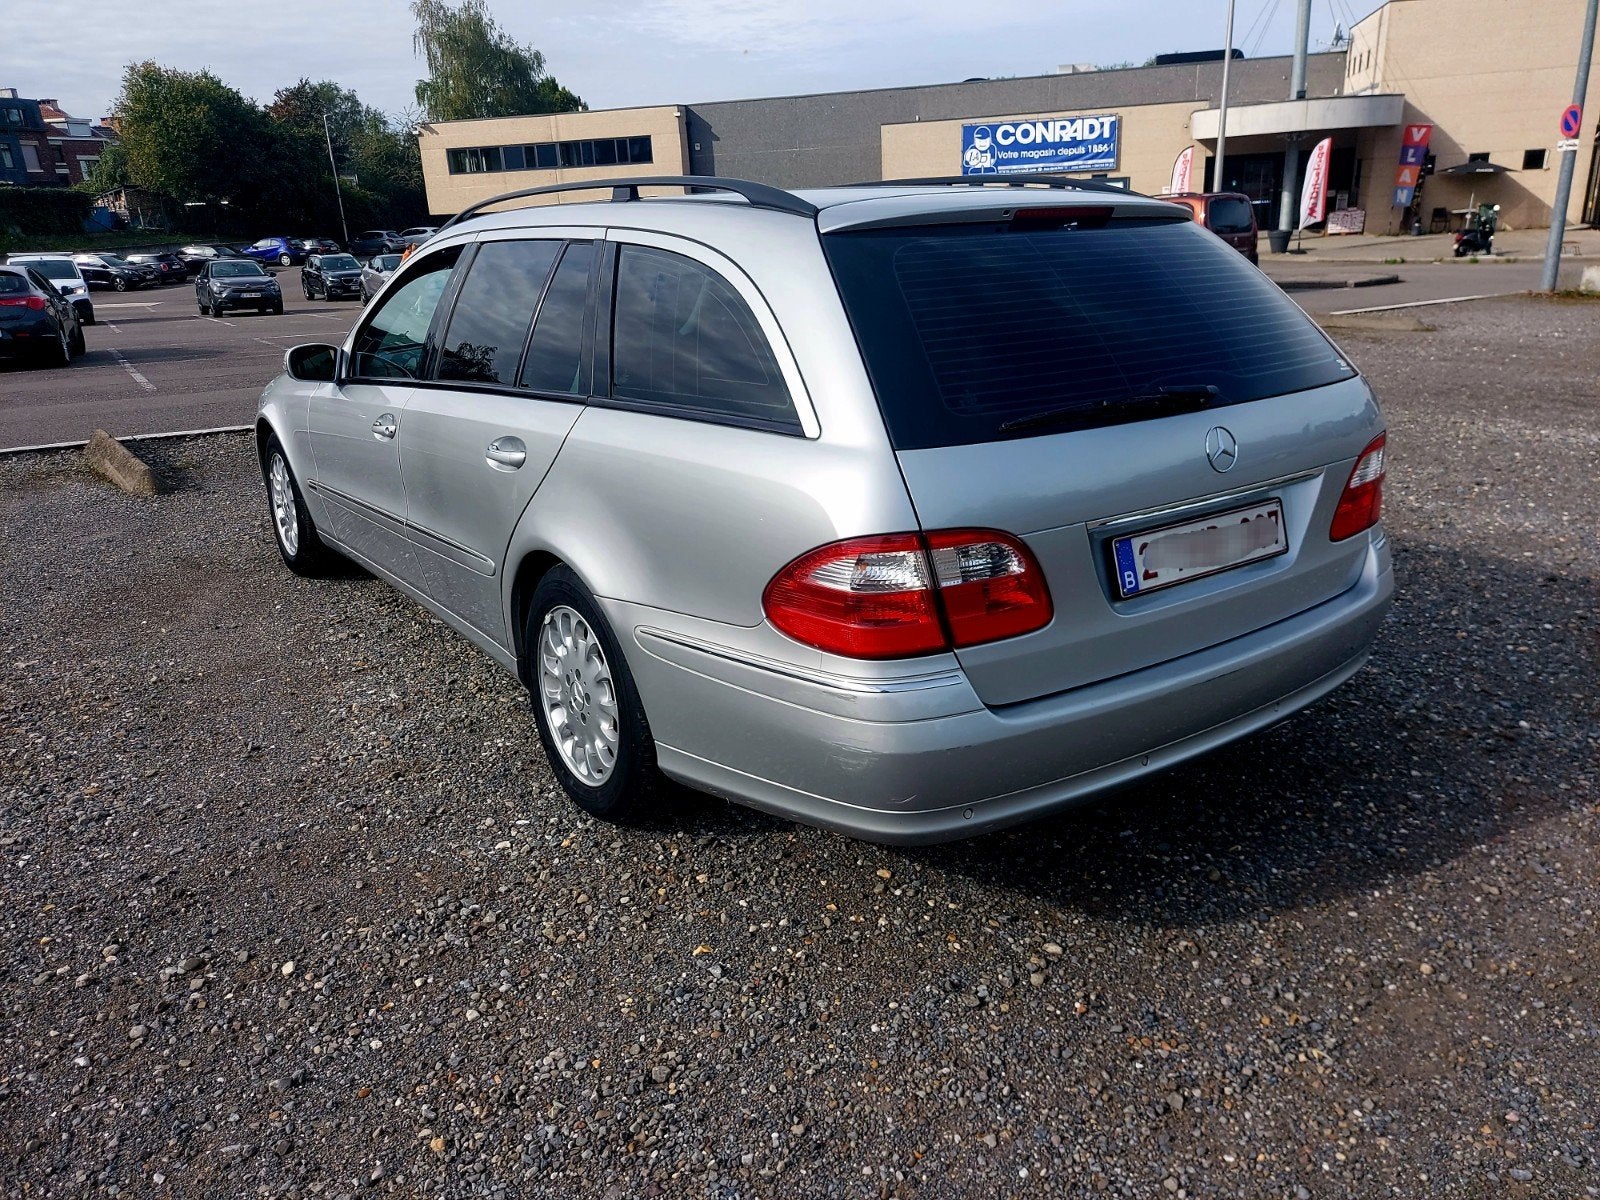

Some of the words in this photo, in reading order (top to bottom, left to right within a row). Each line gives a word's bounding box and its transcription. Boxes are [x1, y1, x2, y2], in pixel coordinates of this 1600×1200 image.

[996, 115, 1116, 146] CONRADT
[998, 150, 1019, 159] Votre
[1020, 147, 1055, 159] magasin
[1057, 145, 1086, 157] depuis
[1088, 143, 1108, 153] 1856
[1396, 127, 1427, 204] VLAN
[1124, 571, 1136, 589] B
